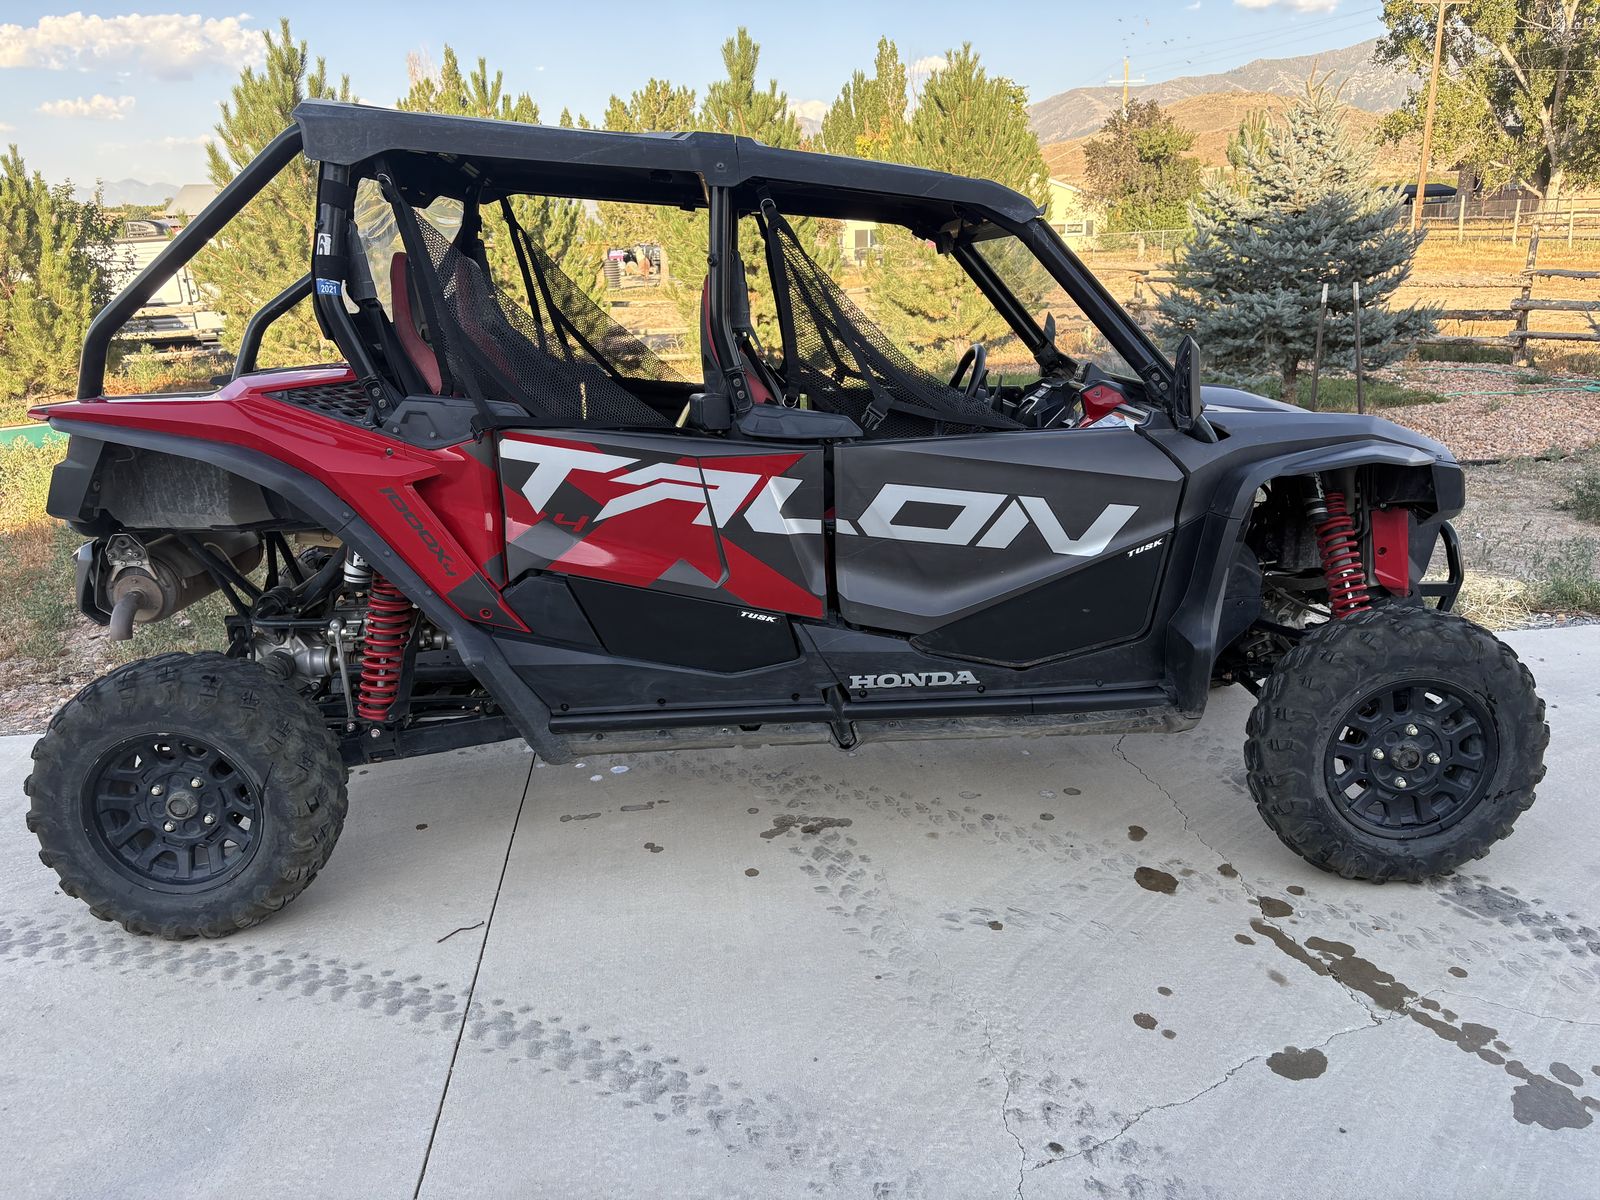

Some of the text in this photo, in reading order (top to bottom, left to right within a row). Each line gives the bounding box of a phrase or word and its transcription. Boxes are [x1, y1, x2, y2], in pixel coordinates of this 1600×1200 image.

[320, 284, 337, 294] 2021
[499, 438, 1140, 557] TALON
[1127, 537, 1163, 557] TUSK
[740, 610, 777, 623] TUSK
[849, 670, 980, 689] HONDA
